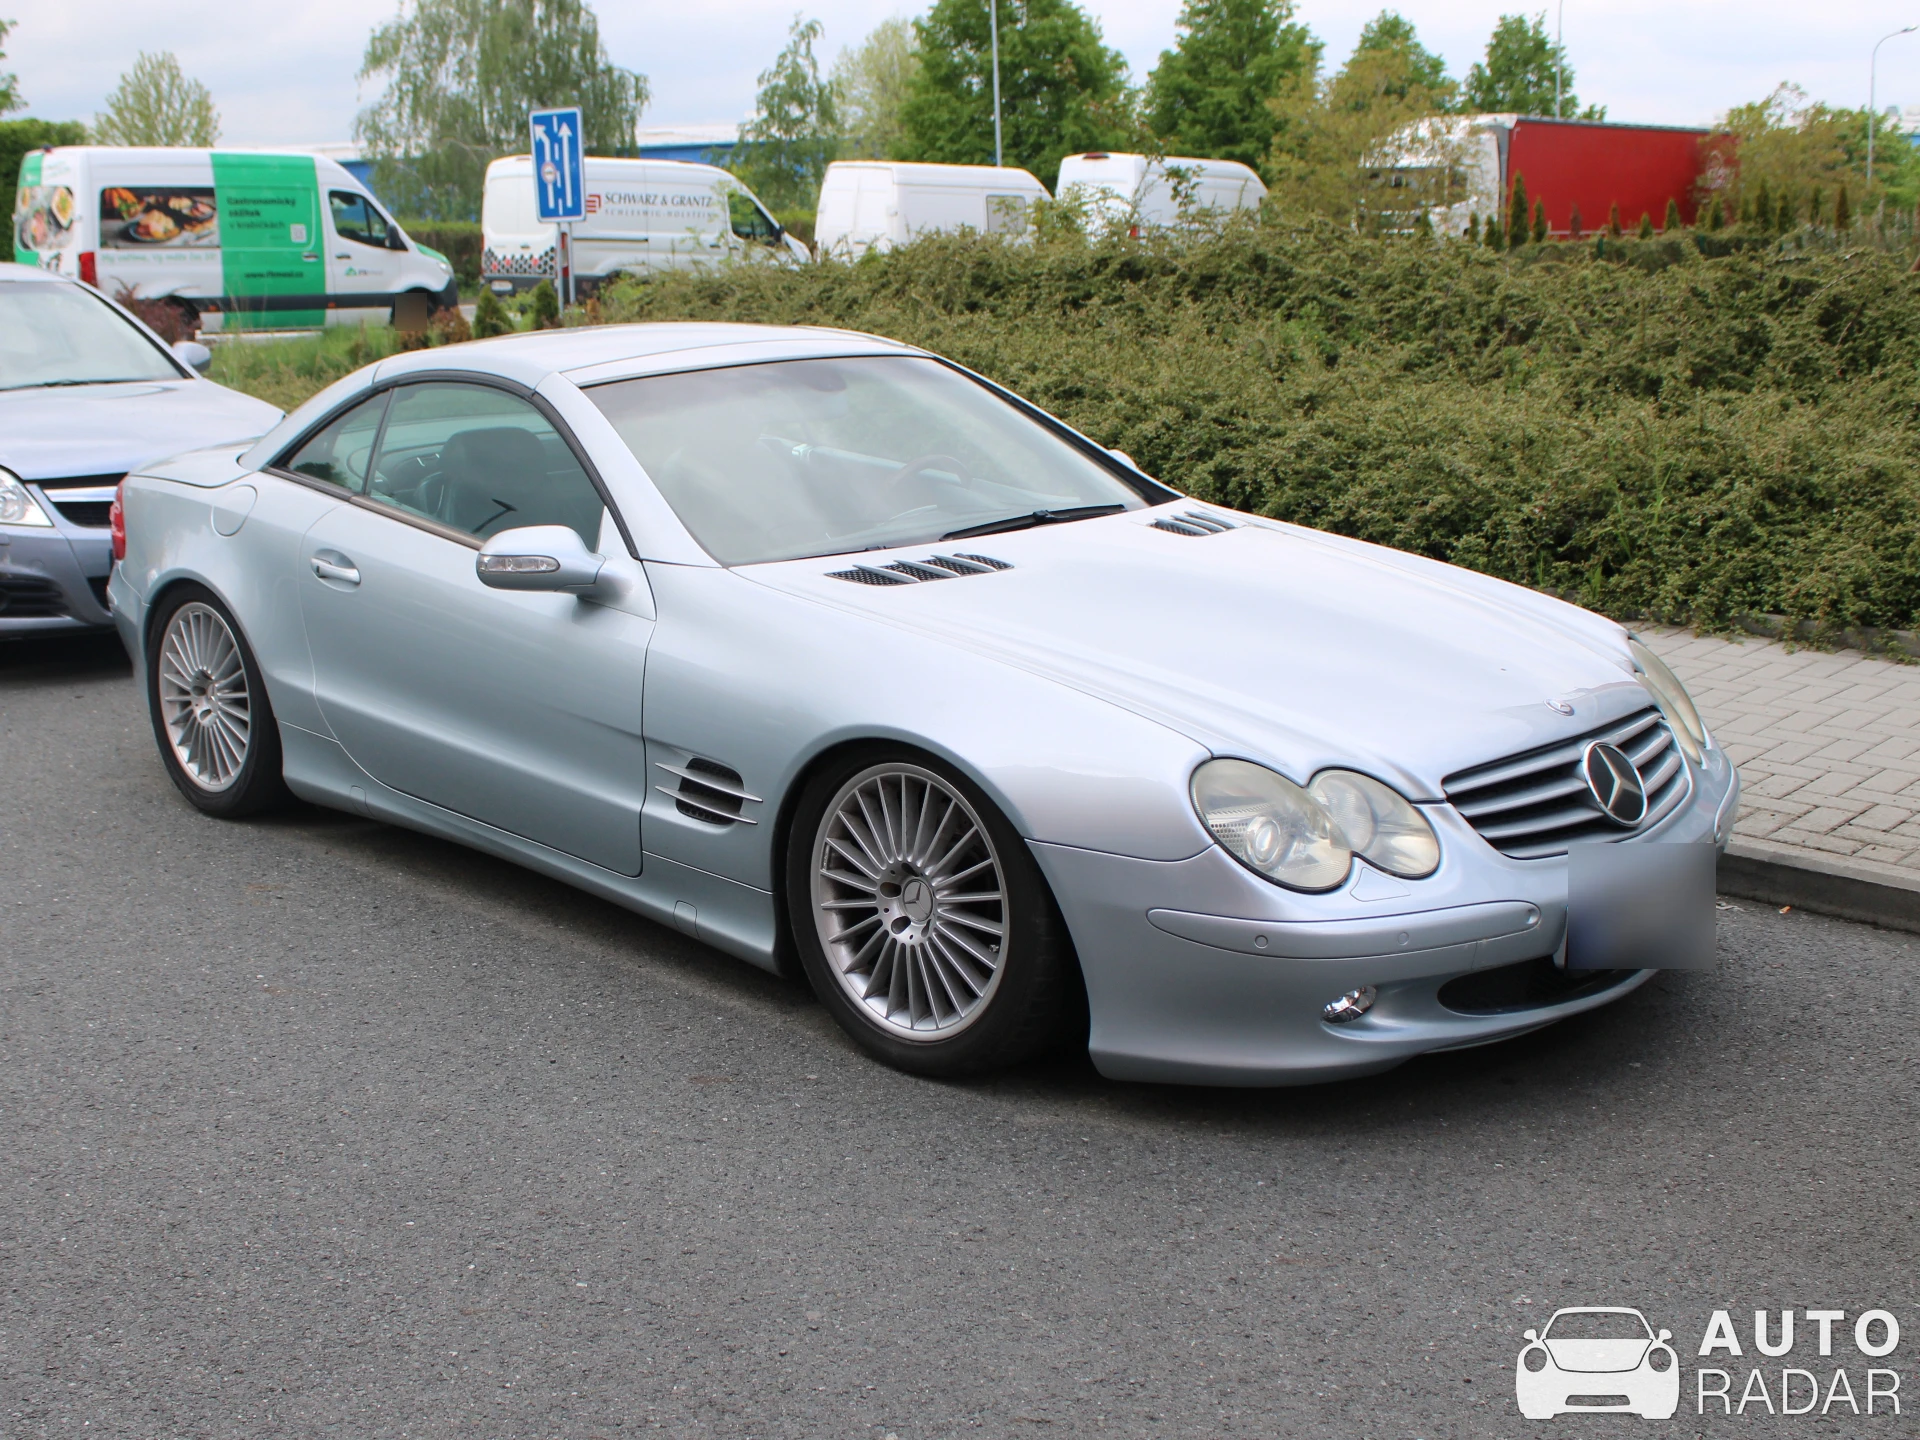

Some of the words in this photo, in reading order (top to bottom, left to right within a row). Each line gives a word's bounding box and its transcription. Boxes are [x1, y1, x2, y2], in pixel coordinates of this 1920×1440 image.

[604, 192, 658, 206] SCHWARZ
[660, 193, 668, 206] &
[671, 194, 713, 208] GRANTZ
